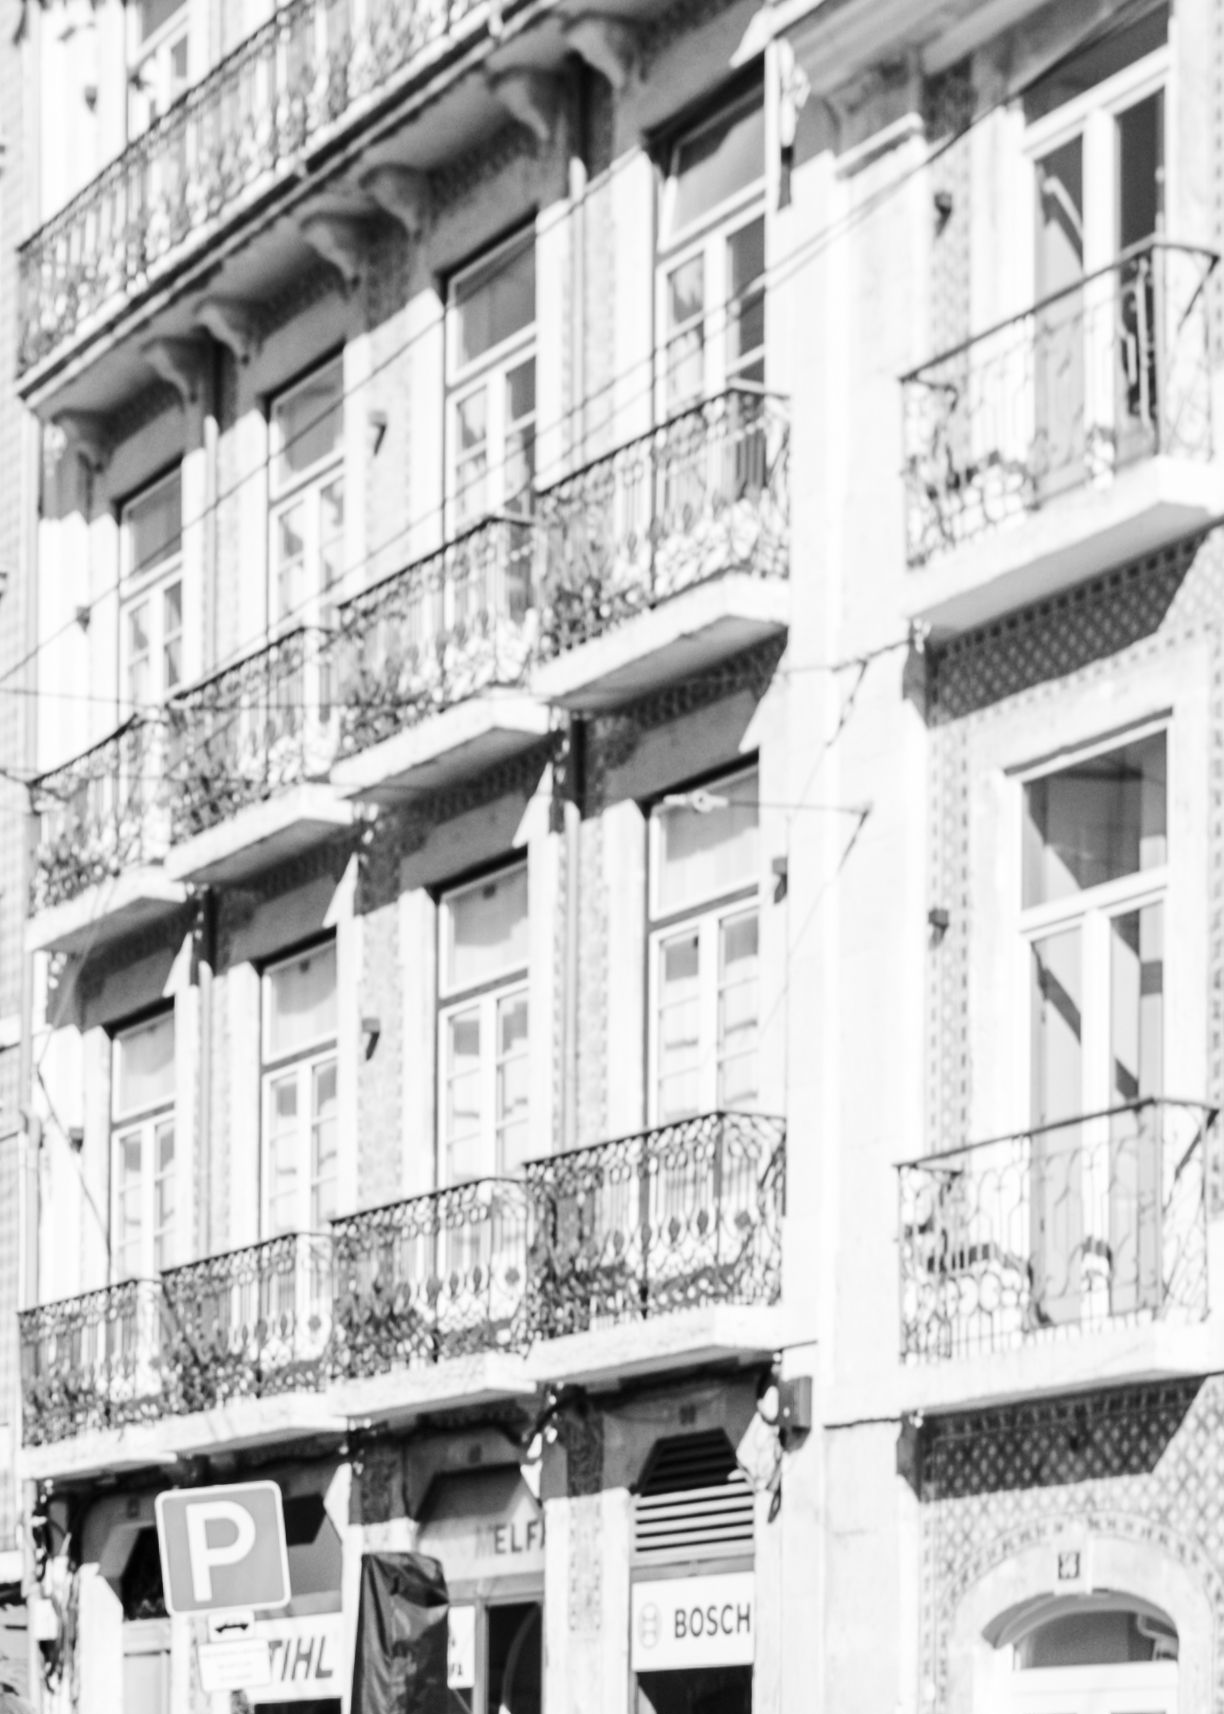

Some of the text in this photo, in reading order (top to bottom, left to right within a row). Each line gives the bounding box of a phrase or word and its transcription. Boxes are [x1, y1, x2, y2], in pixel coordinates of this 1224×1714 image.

[185, 1500, 256, 1602] P
[673, 1601, 751, 1639] BOSCH
[267, 1635, 334, 1681] TIHL
